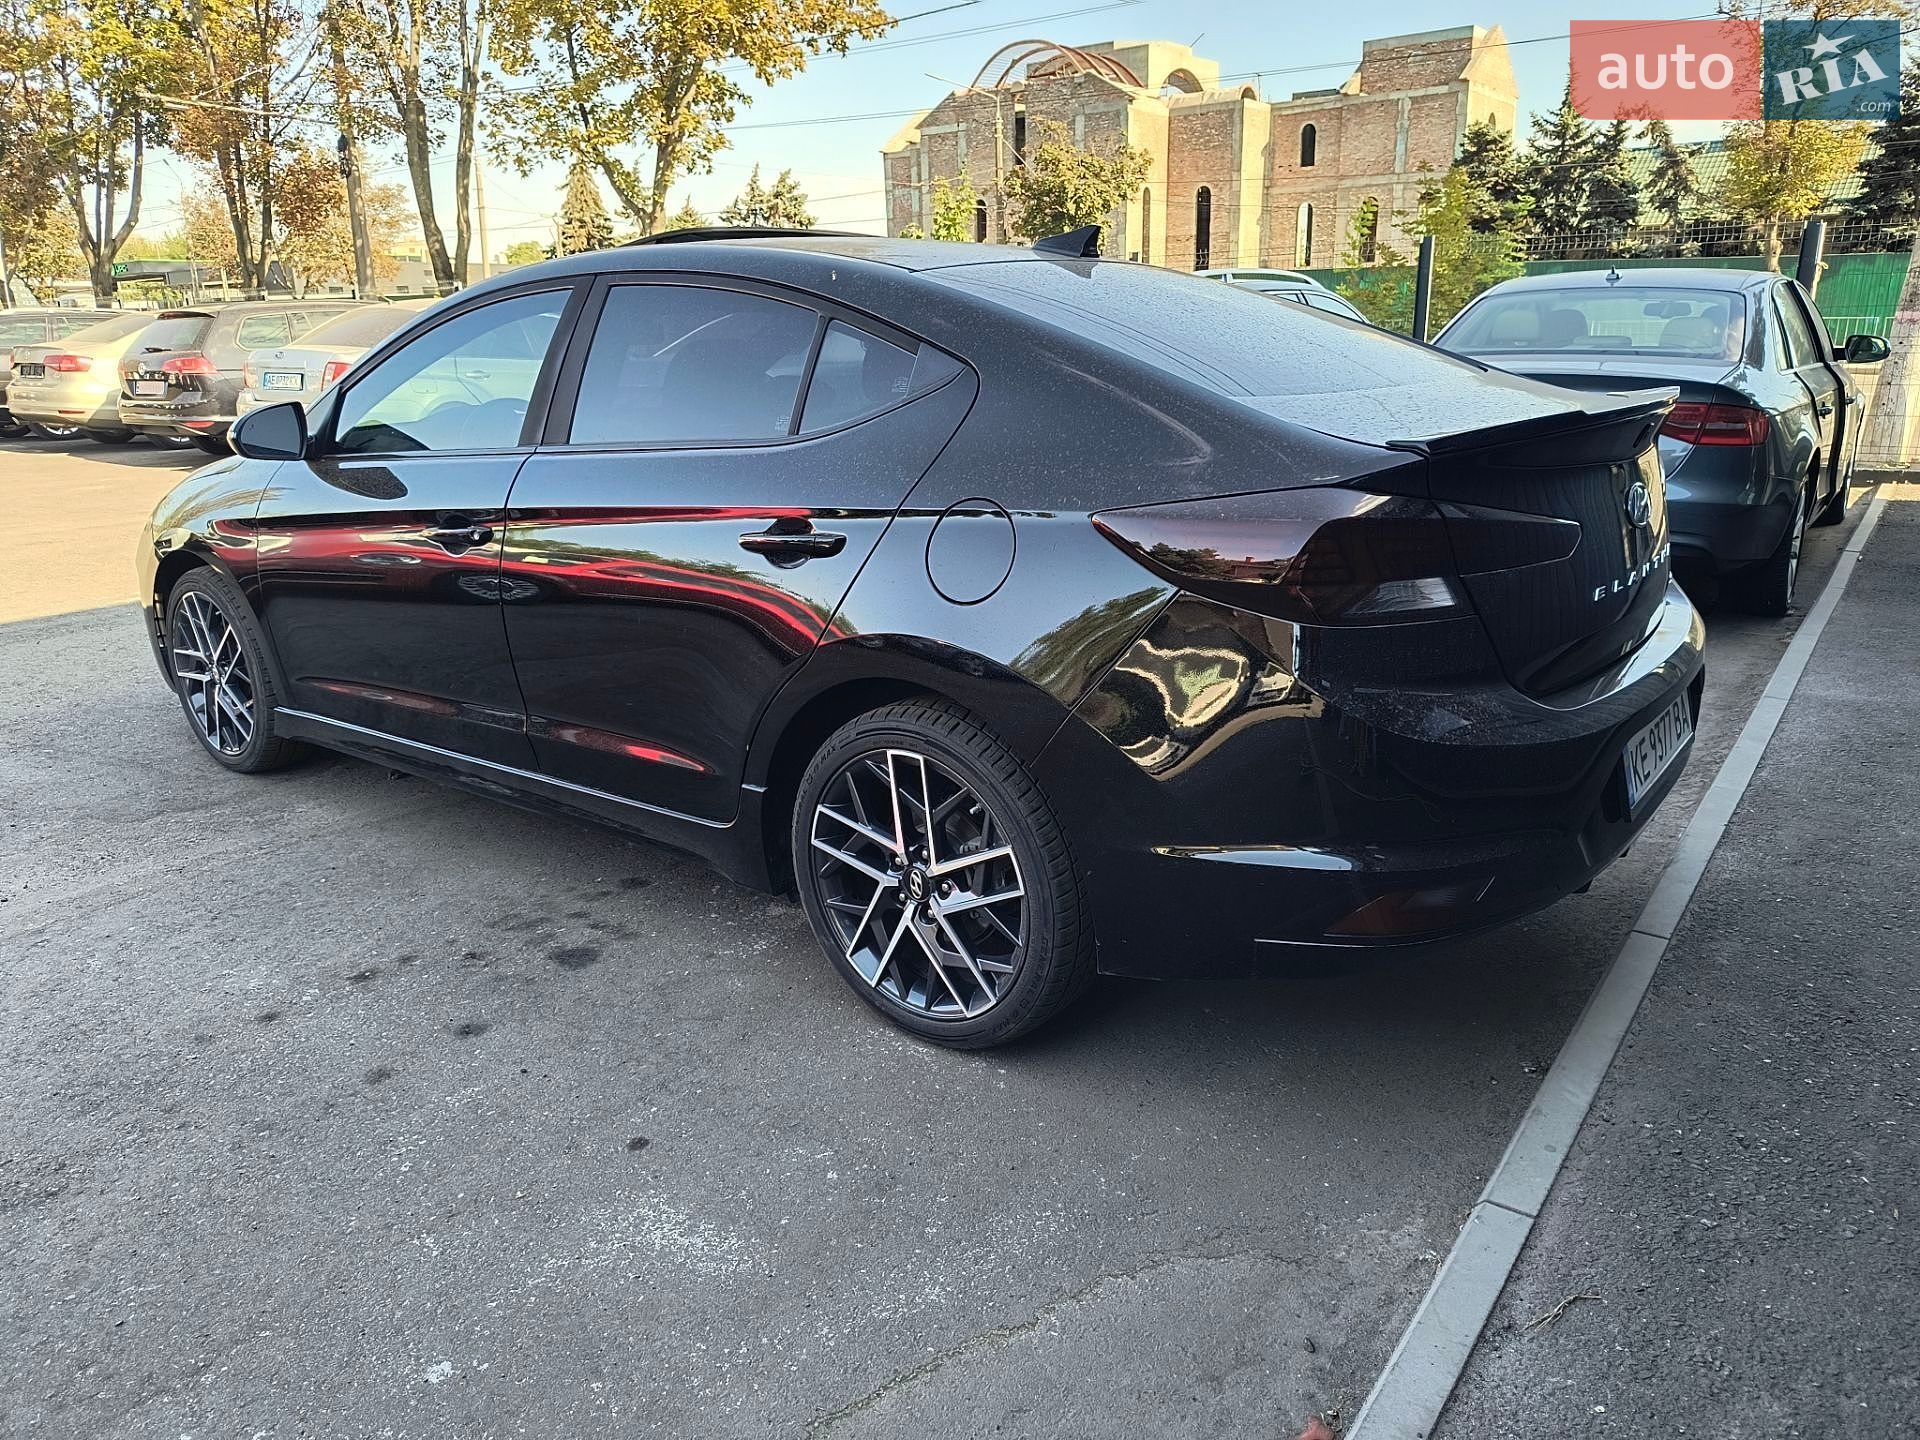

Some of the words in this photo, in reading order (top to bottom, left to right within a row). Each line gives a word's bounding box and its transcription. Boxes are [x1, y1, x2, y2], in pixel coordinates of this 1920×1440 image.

[1630, 736, 1650, 792] KE
[1649, 709, 1673, 770] 9377
[1672, 694, 1690, 741] BA
